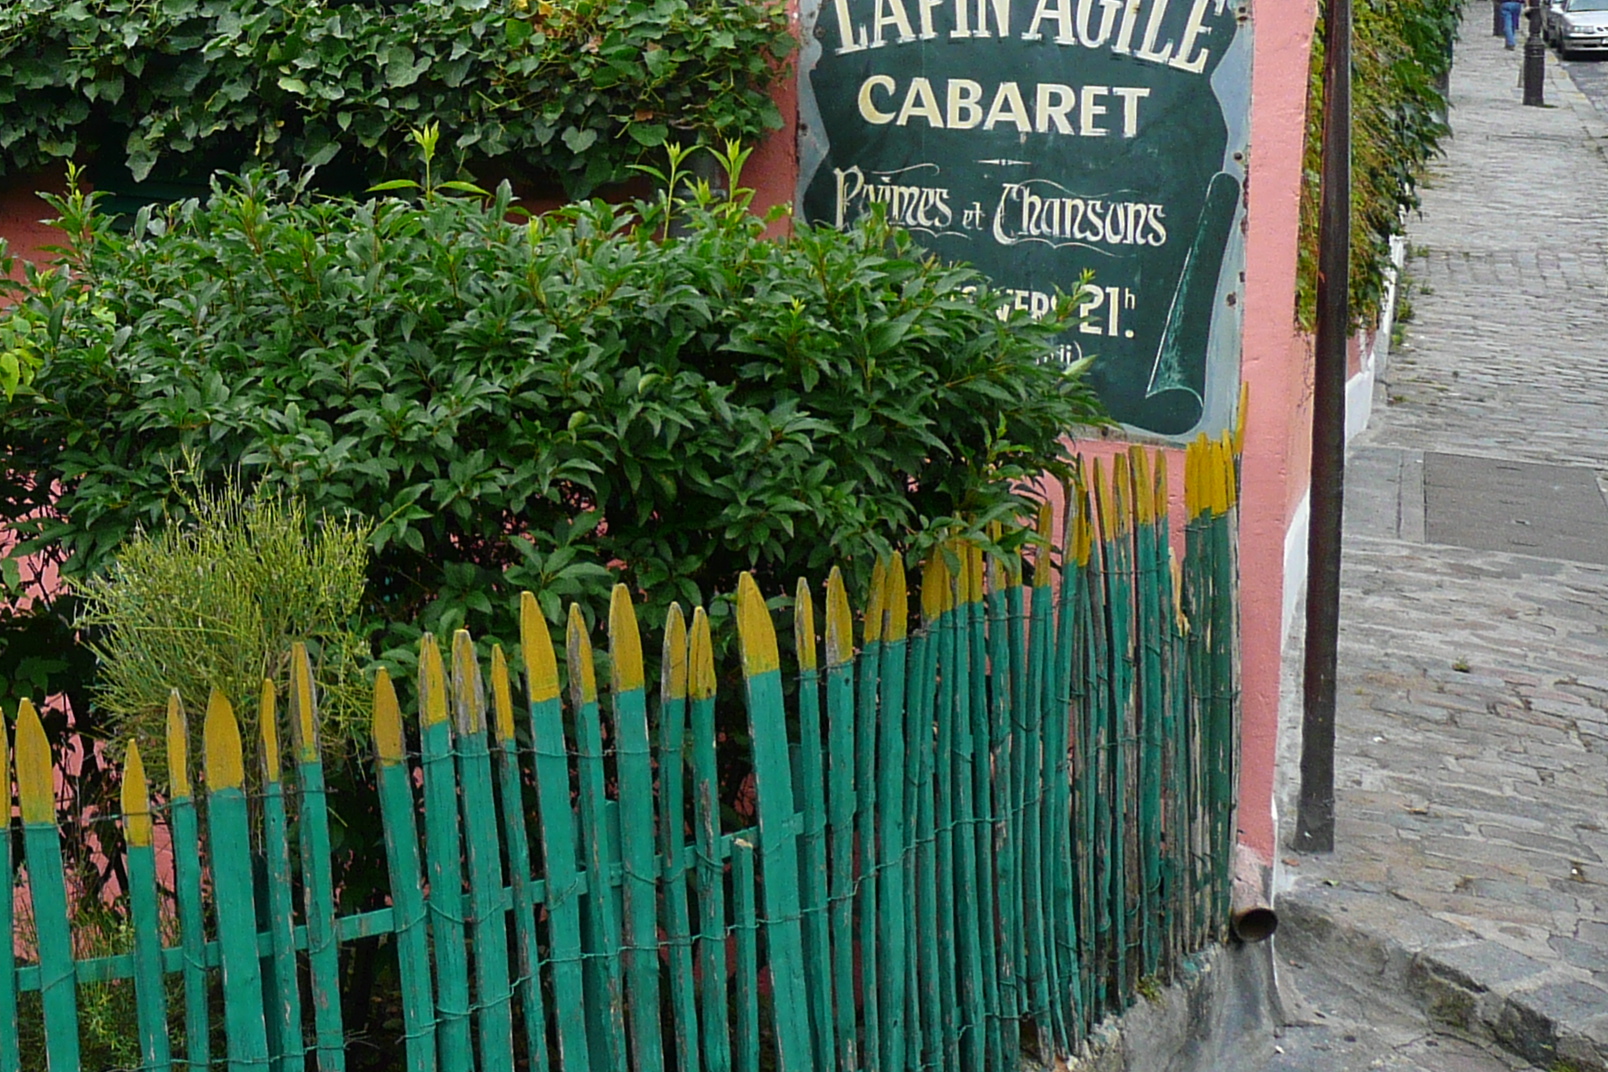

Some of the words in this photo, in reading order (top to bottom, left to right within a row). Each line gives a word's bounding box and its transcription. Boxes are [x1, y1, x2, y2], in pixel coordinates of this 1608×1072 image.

[857, 74, 1151, 138] CABARET
[962, 201, 987, 230] et
[993, 182, 1167, 247] Chansons
